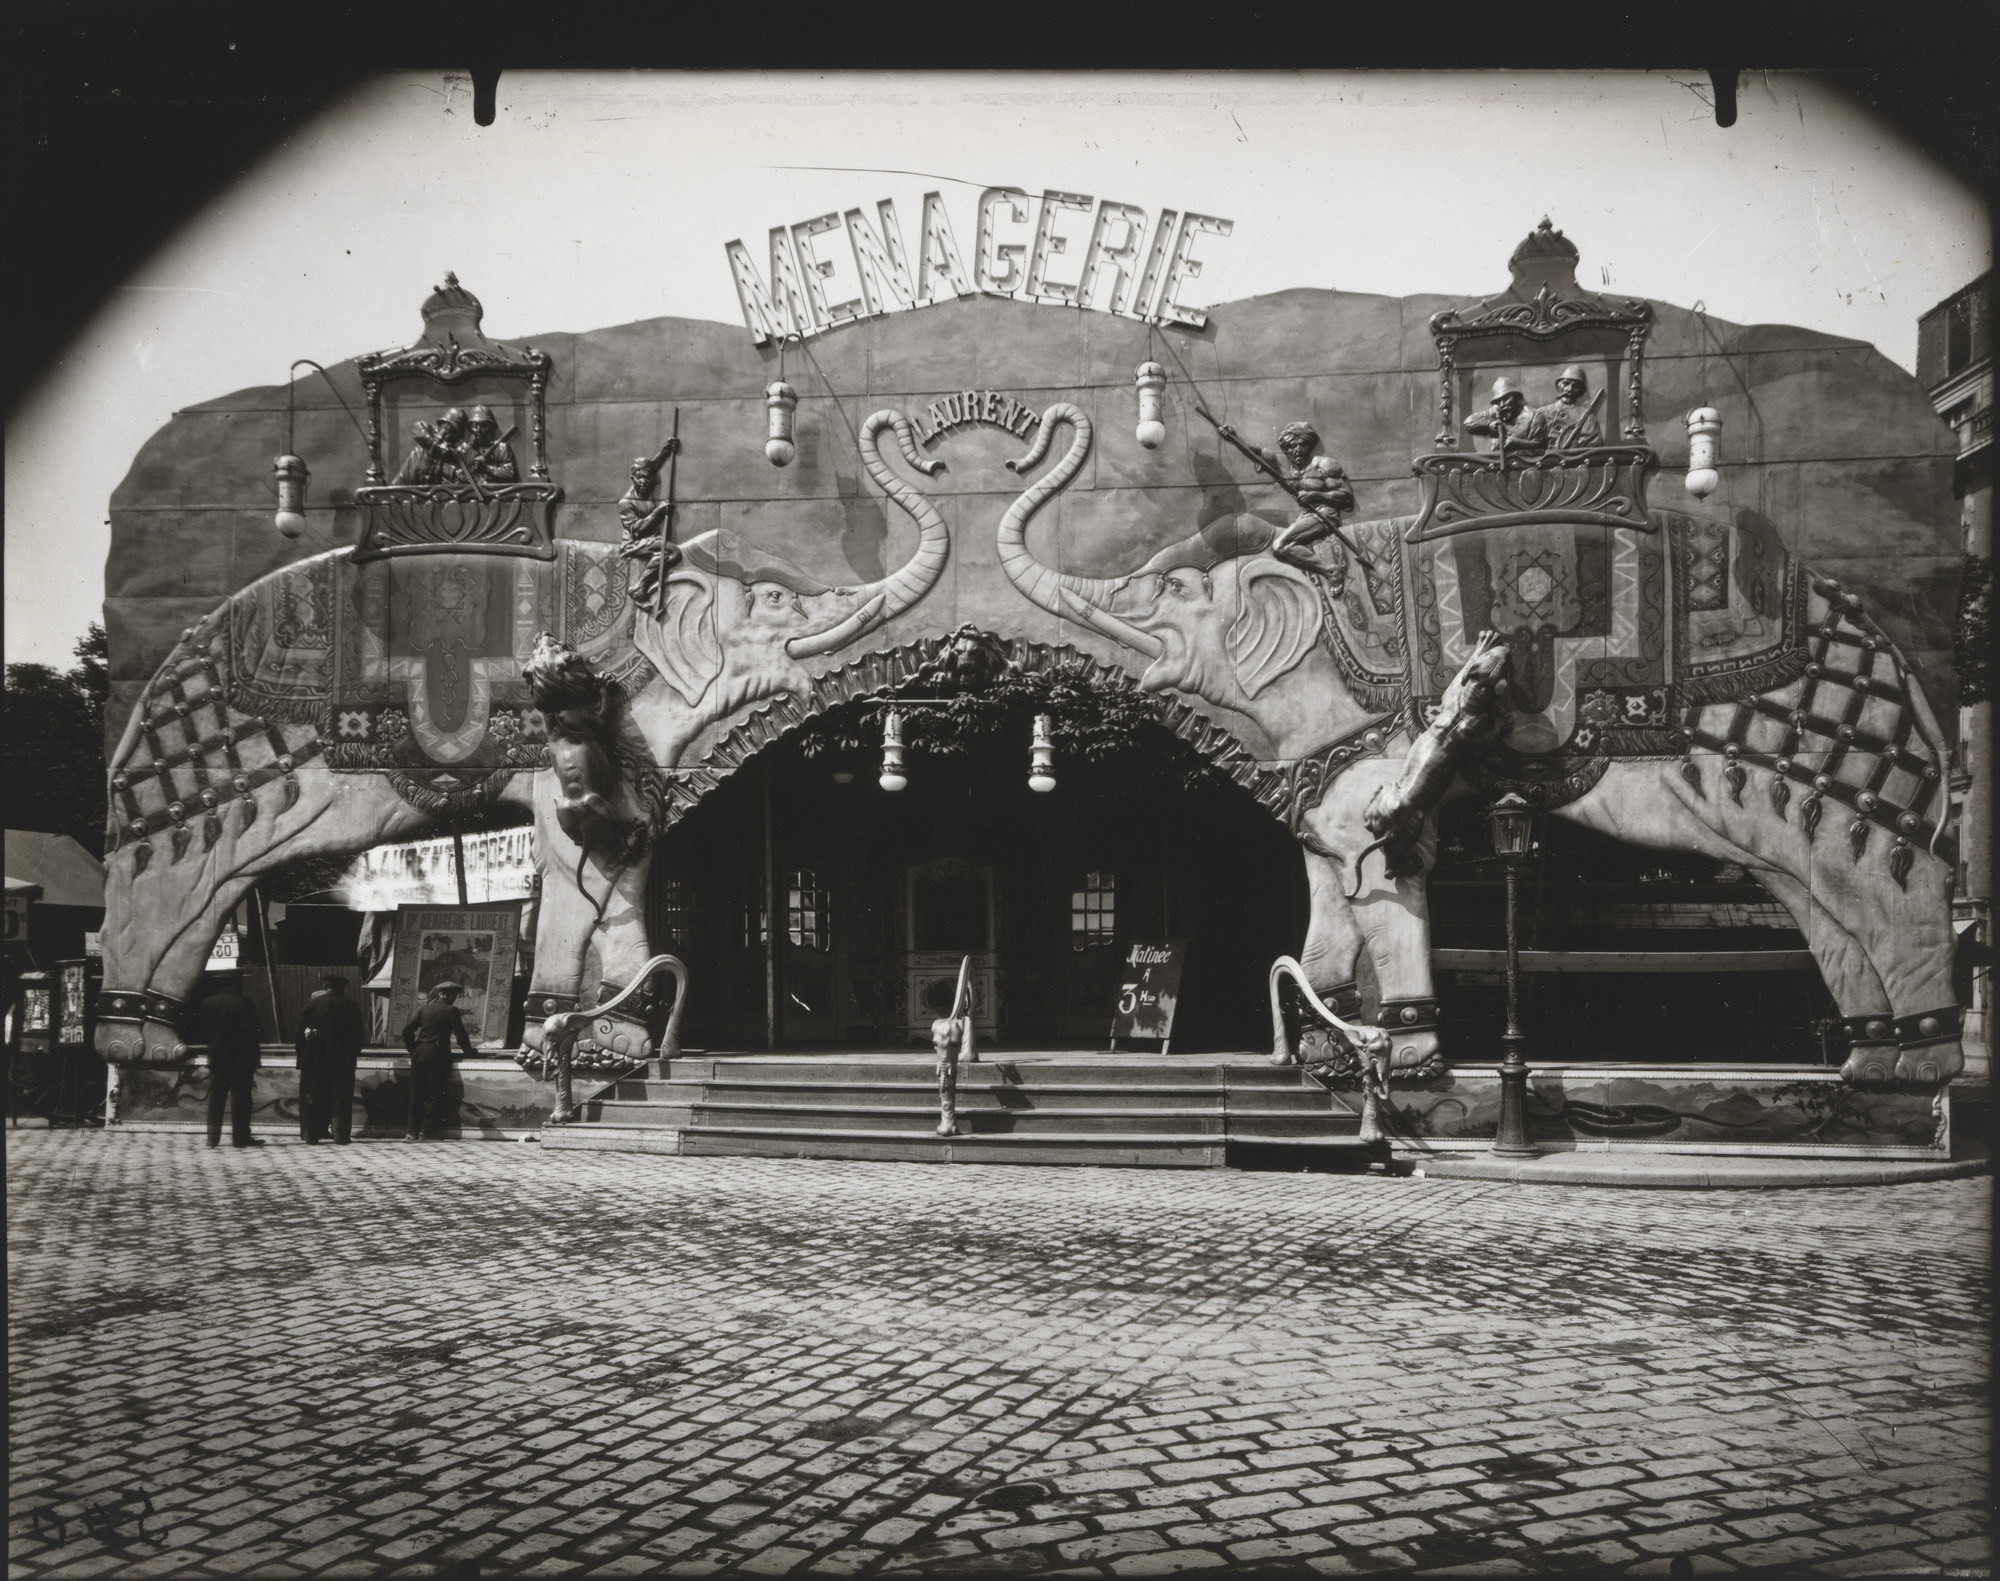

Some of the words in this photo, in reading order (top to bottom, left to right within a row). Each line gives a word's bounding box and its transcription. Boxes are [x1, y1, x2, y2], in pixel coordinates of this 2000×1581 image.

[725, 186, 1235, 347] MENAGERIE
[910, 390, 1040, 446] LAURENT
[462, 831, 536, 874] ORDEAUX
[1118, 983, 1138, 1015] 3
